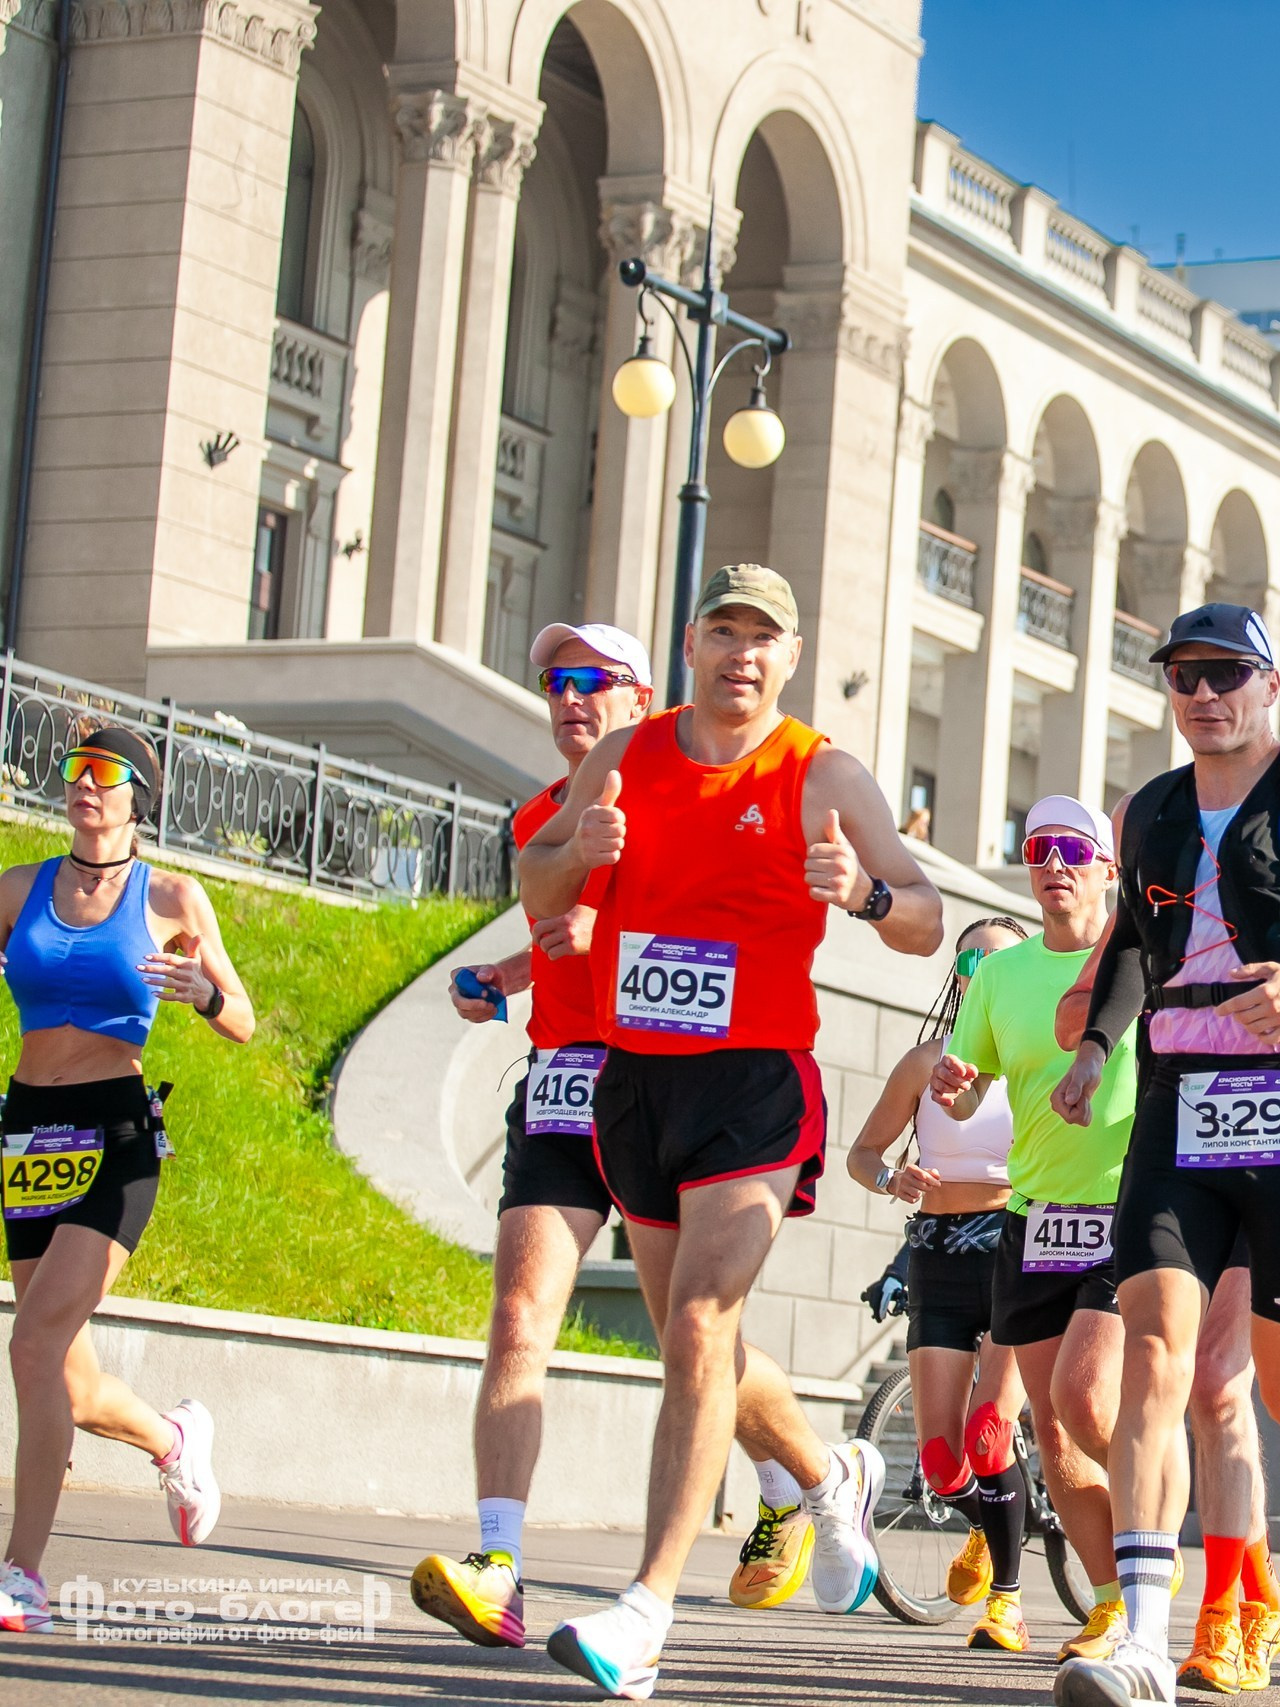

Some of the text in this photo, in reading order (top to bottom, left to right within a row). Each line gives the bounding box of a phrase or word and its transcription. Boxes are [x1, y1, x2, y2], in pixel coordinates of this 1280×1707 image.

[620, 965, 727, 1009] 4095
[661, 1008, 708, 1018] АЛЕКСАНДР
[1202, 1141, 1229, 1149] ЛИПОВ
[8, 1156, 97, 1192] 4298
[1033, 1218, 1105, 1250] 4113
